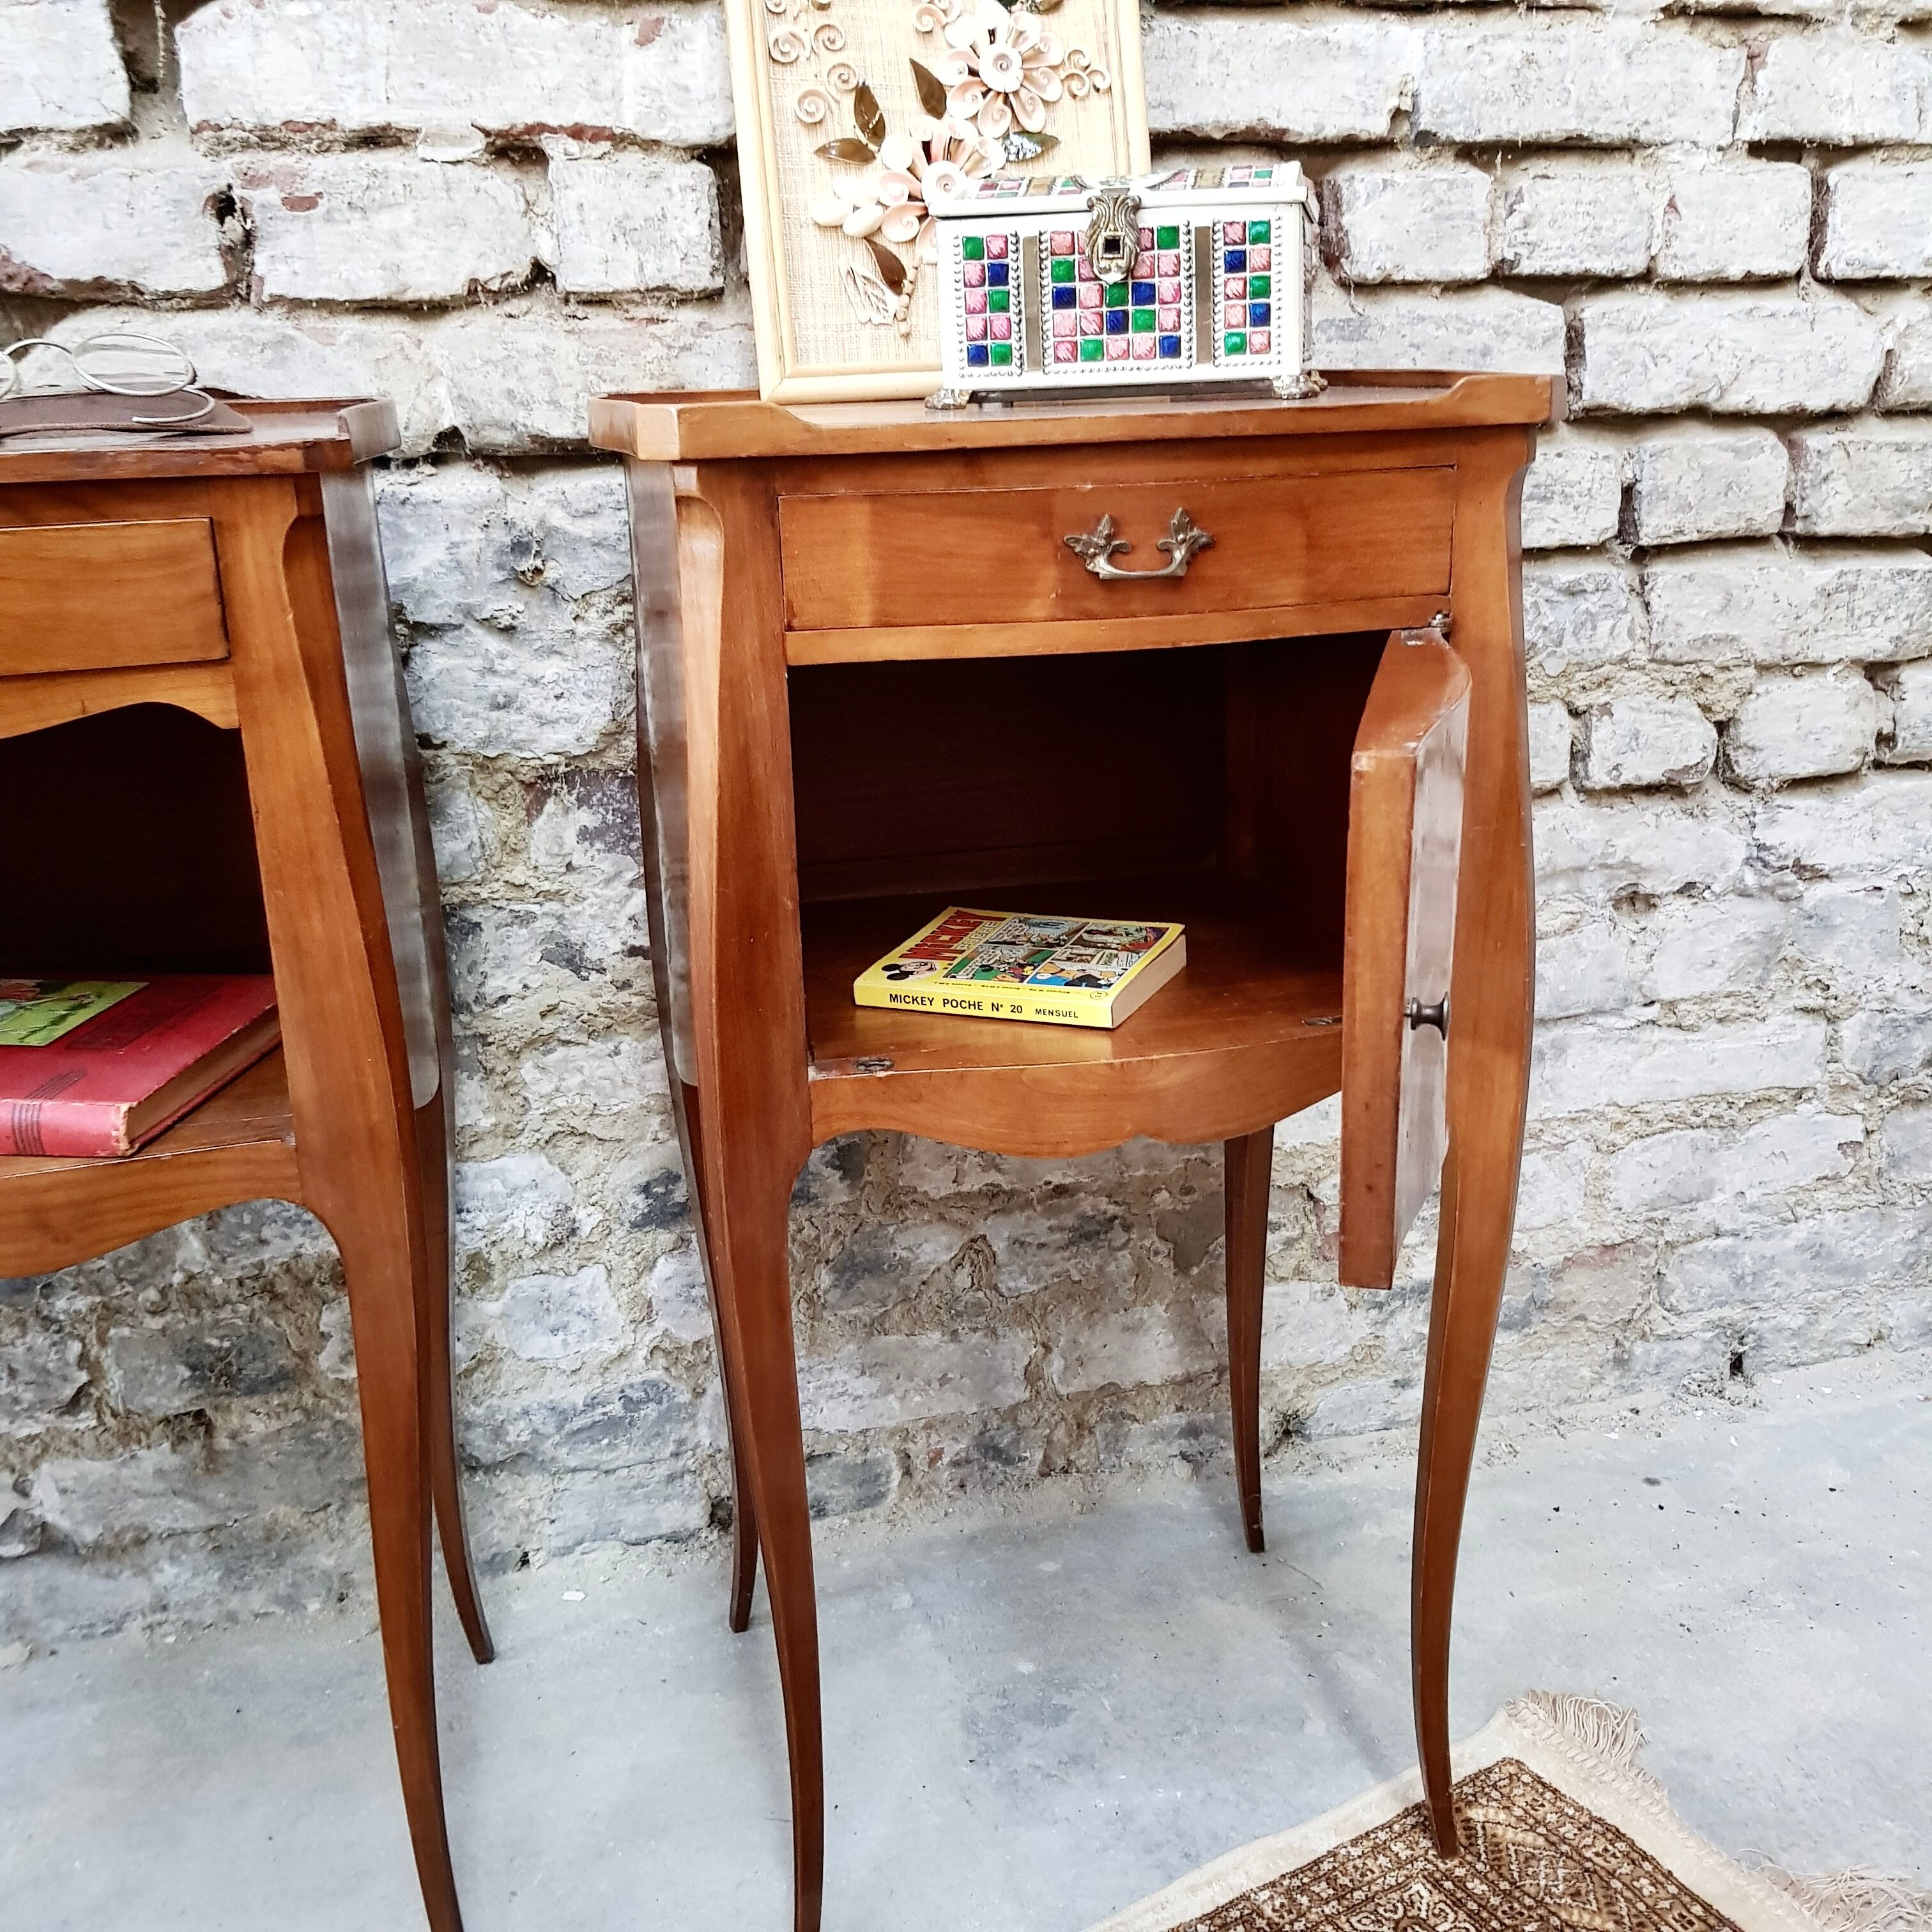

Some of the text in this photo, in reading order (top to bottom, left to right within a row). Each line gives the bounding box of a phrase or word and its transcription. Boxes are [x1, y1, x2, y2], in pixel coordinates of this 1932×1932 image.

[954, 921, 1000, 951] POCHE
[889, 993, 934, 1006] MICKEY
[942, 999, 983, 1011] POCHE
[1010, 1004, 1023, 1014] 20
[1035, 1008, 1078, 1018] MENSUEL
